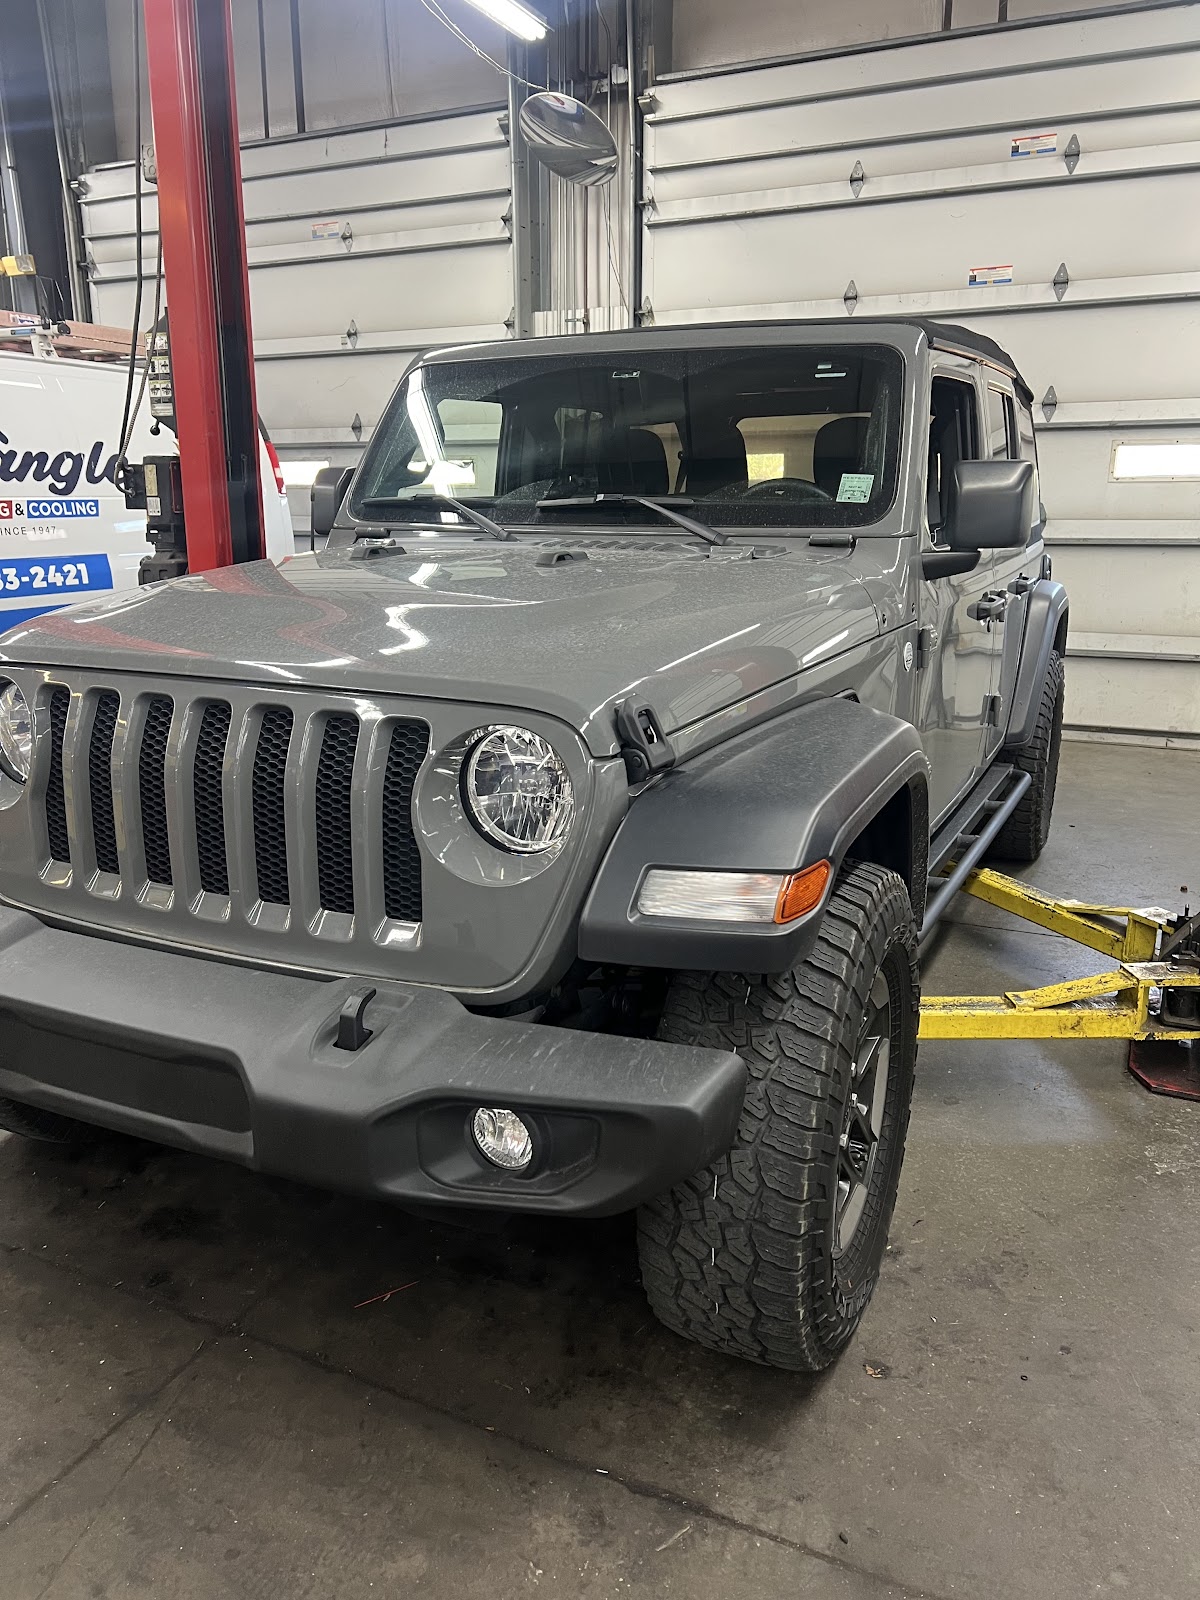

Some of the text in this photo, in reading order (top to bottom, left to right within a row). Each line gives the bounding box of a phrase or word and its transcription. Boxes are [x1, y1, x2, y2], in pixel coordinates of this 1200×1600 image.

[15, 503, 25, 516] &
[28, 501, 97, 516] COOLING
[32, 526, 56, 535] 1947
[0, 563, 89, 591] 3-2421
